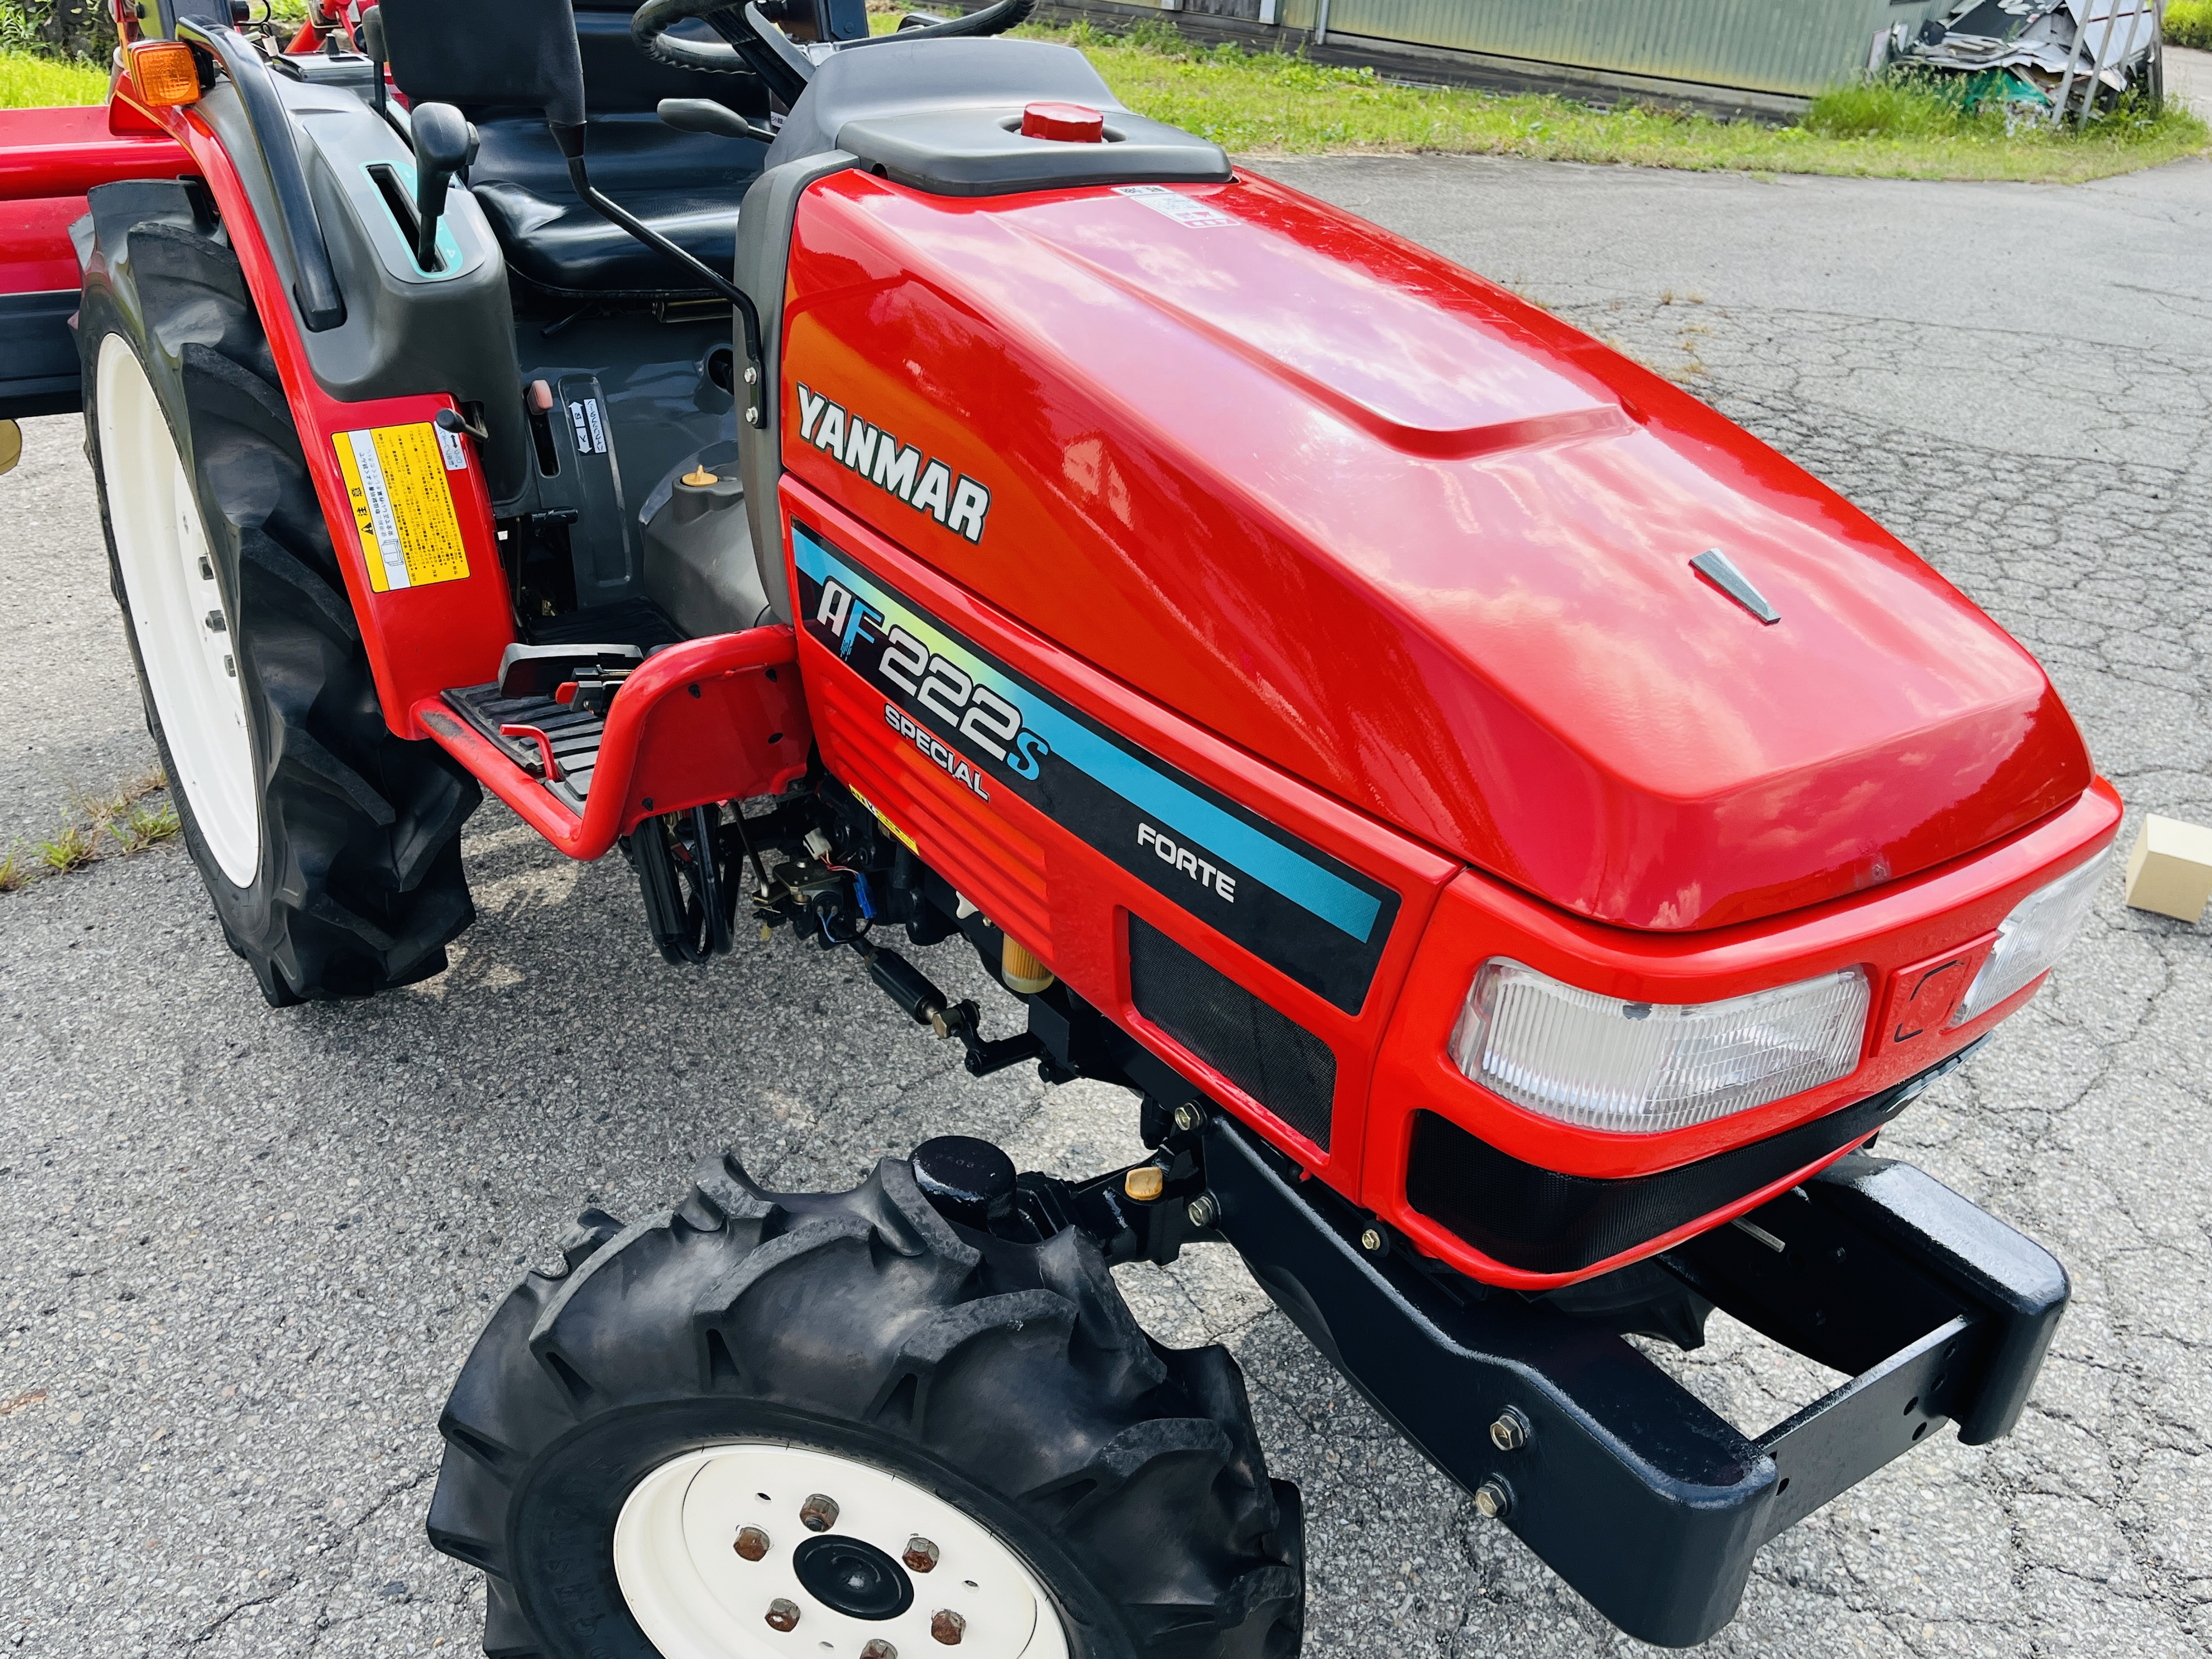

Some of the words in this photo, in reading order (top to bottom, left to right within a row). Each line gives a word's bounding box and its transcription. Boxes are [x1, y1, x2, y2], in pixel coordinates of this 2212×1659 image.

[797, 382, 991, 544] YANMAR
[884, 703, 990, 803] SPECIAL
[1137, 823, 1236, 903] FORTE
